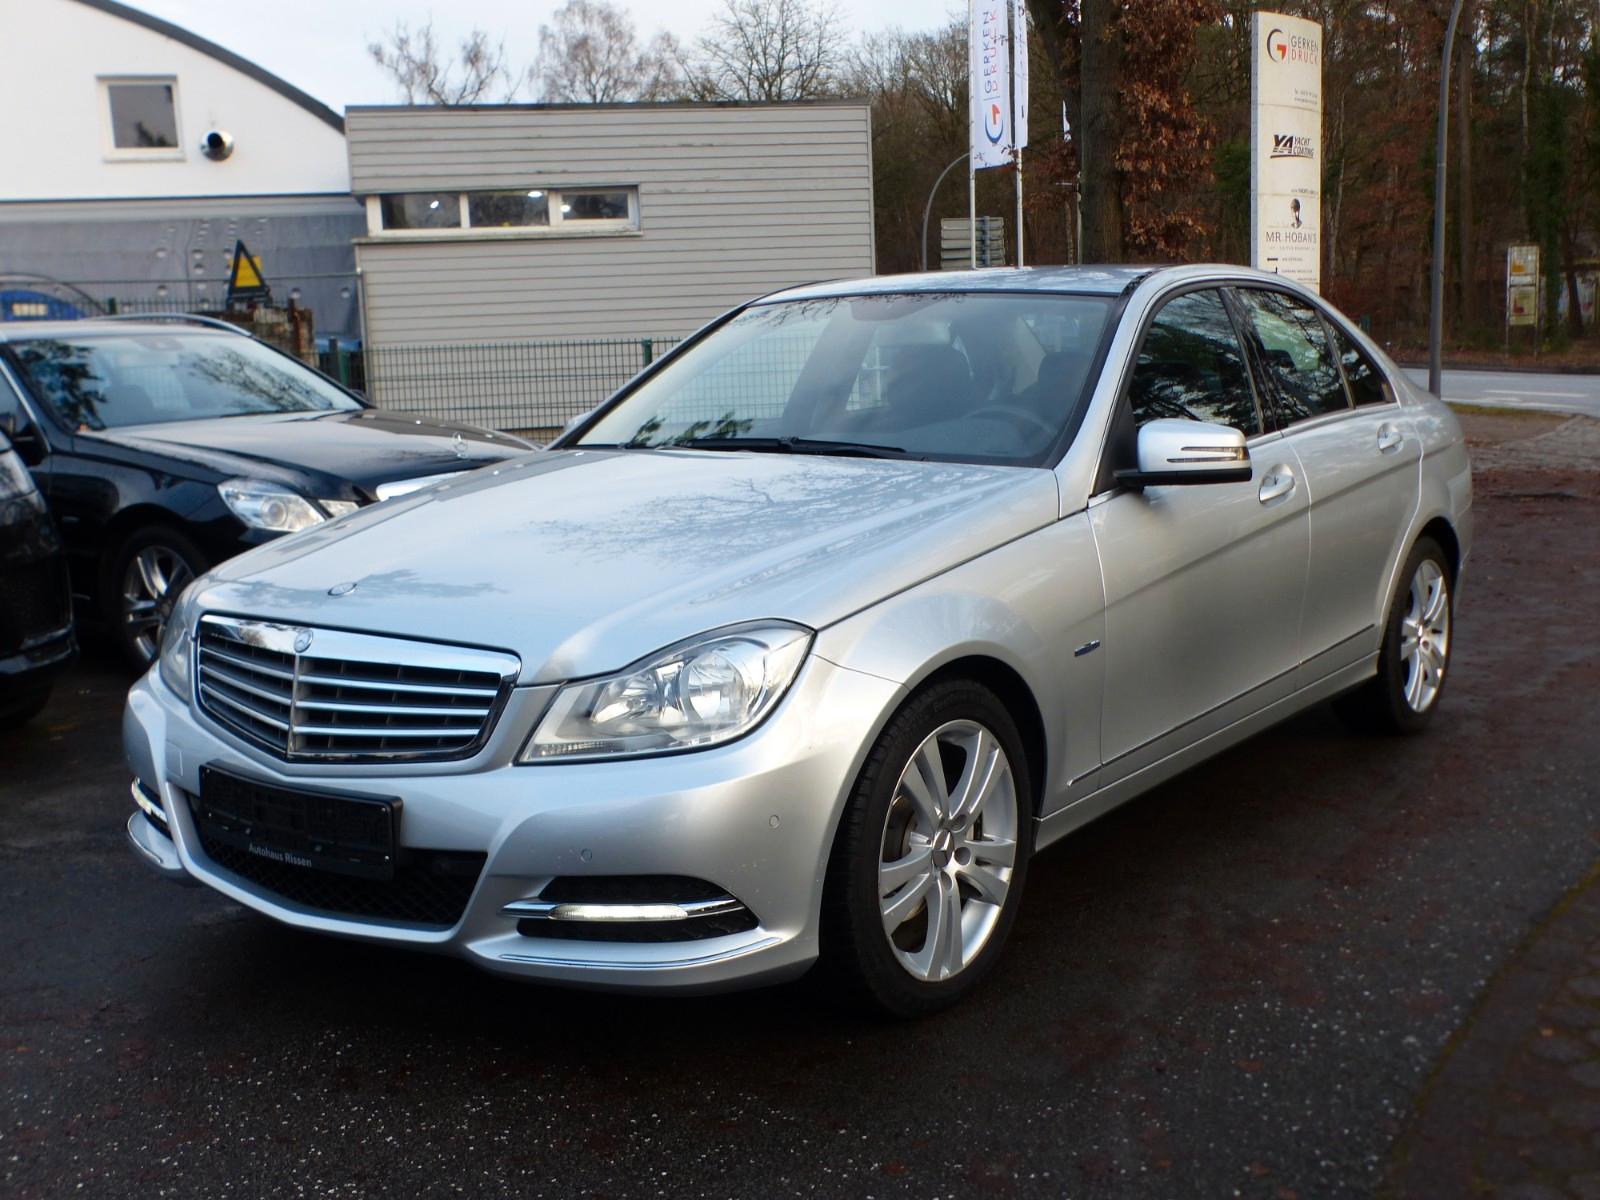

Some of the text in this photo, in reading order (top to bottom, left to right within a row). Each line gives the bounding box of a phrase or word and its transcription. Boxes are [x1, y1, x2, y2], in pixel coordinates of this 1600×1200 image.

[983, 11, 992, 94] GERKEN
[1290, 35, 1319, 54] GERKEN
[1265, 231, 1282, 243] MR
[248, 842, 284, 861] Autohaus
